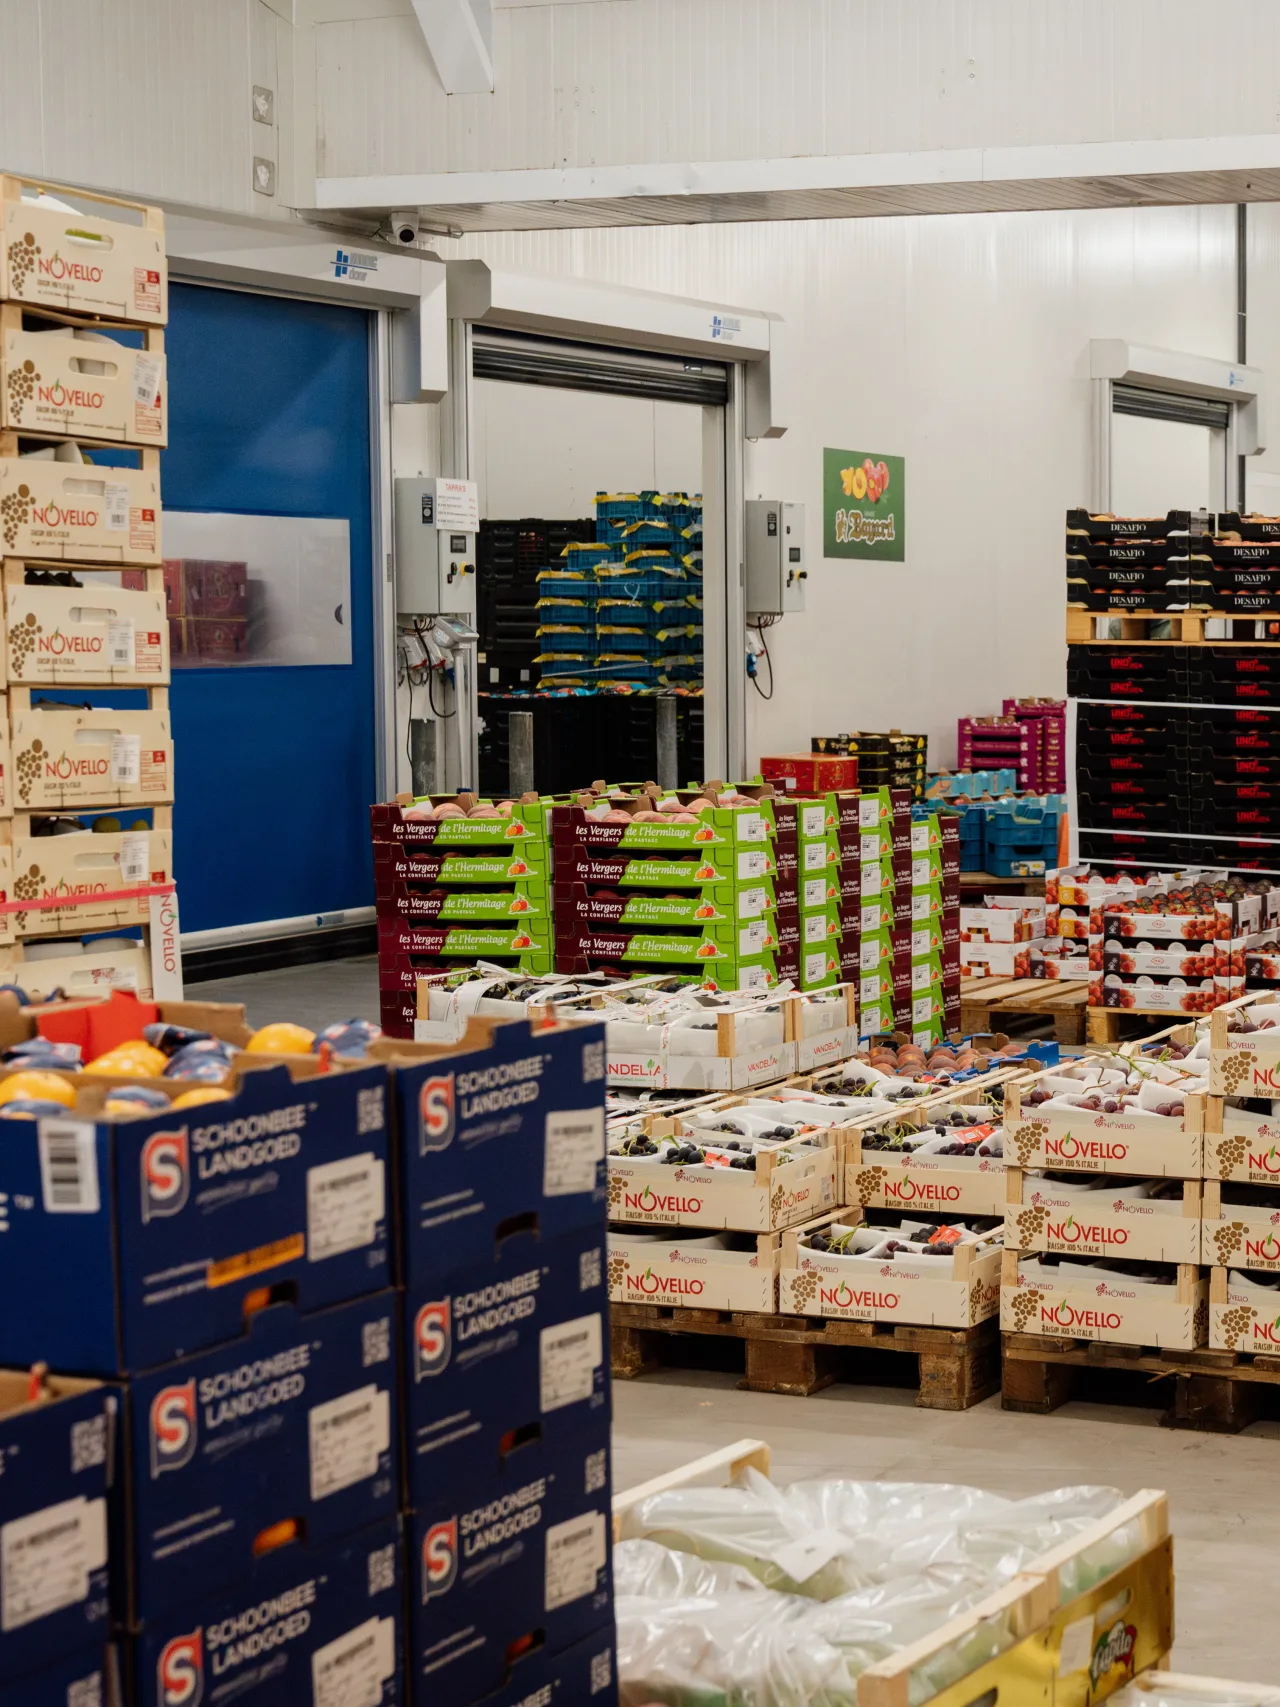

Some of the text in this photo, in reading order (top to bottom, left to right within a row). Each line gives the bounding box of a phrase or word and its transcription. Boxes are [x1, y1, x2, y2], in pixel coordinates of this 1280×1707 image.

[39, 256, 103, 283] NOVELLO
[39, 384, 104, 408] NOVELLO
[33, 505, 98, 528] NOVELLO
[1110, 523, 1147, 532] DESAFIO
[1109, 549, 1145, 557] DESAFIO
[1233, 548, 1269, 556] DESAFIO
[1109, 572, 1145, 580] DESAFIO
[1234, 574, 1271, 582] DESAFIO
[1109, 596, 1145, 604] DESAFIO
[1234, 597, 1271, 605] DESAFIO
[39, 634, 103, 655] NOVELLO
[46, 758, 109, 779] NOVELLO
[393, 823, 502, 835] les Vergers de l'Hermitage
[576, 825, 691, 840] les Vergers de l'Hermitage
[395, 861, 504, 874] les Vergers de l'Hermitage
[577, 862, 692, 876] les Vergers de l'Hermitage
[397, 898, 507, 910] les Vergers de l'Hermitage
[577, 901, 691, 915] les Vergers de l'Hermitage
[159, 895, 177, 974] NOVELLO
[399, 934, 508, 946] les Vergers de l'Hermitage
[579, 939, 694, 953] les Vergers de l'Hermitage
[461, 1082, 539, 1119] LANDGOED
[1104, 1121, 1135, 1130] NOVELLO
[1045, 1136, 1127, 1160] NOVELLO
[198, 1134, 302, 1180] LANDGOED
[1081, 1160, 1099, 1169] ITALIE
[684, 1174, 712, 1184] NOVELLO
[782, 1187, 809, 1208] NOVELLO
[884, 1179, 961, 1201] NOVELLO
[625, 1190, 702, 1214] NOVELLO
[1040, 1199, 1070, 1207] NOVELLO
[1122, 1206, 1154, 1214] NOVELLO
[1047, 1221, 1128, 1244] NOVELLO
[627, 1271, 704, 1295] NOVELLO
[820, 1285, 898, 1309] NOVELLO
[1105, 1289, 1136, 1298] NOVELLO
[457, 1296, 535, 1340] LANDGOED
[1041, 1305, 1121, 1329] NOVELLO
[205, 1374, 305, 1428] LANDGOED
[464, 1505, 541, 1557] LANDGOED
[212, 1611, 311, 1675] LANDGOED
